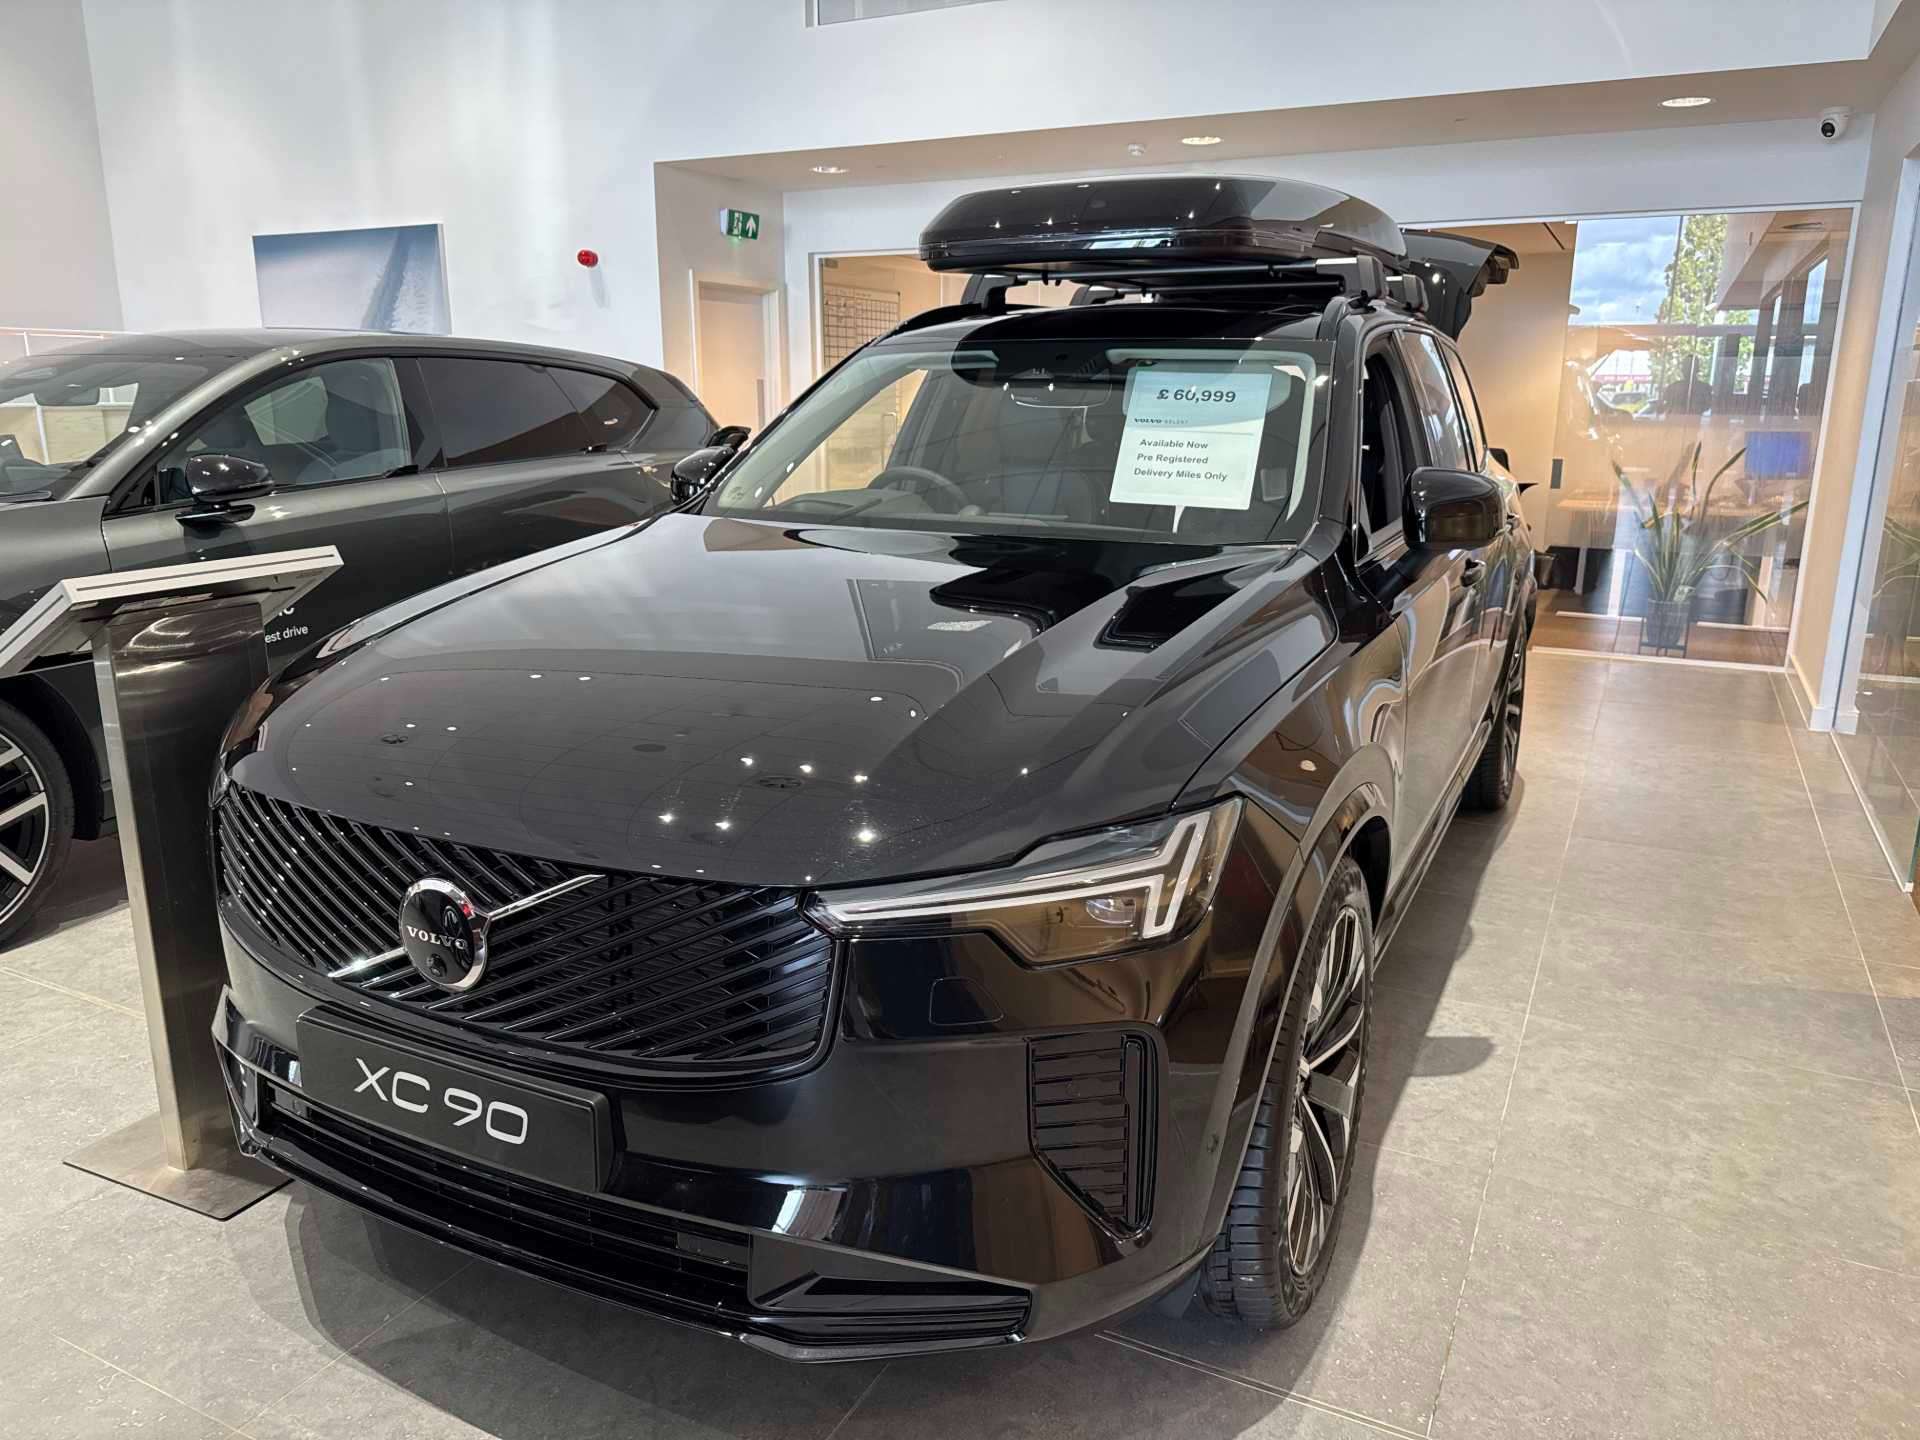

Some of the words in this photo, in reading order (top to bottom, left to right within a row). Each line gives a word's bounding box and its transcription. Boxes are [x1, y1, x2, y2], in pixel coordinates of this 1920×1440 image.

[1156, 389, 1169, 400] £
[1173, 389, 1236, 403] 60,999
[1140, 439, 1184, 449] Available
[1186, 440, 1209, 449] Now
[1136, 453, 1153, 461] Pre
[1155, 454, 1209, 464] Registered
[1133, 467, 1173, 479] Delivery
[1175, 470, 1201, 479] Miles
[1204, 471, 1228, 482] Only
[264, 631, 281, 643] est
[283, 626, 308, 639] drive
[406, 924, 468, 950] VOLVO
[353, 1057, 430, 1113] XC
[444, 1087, 528, 1145] 90
